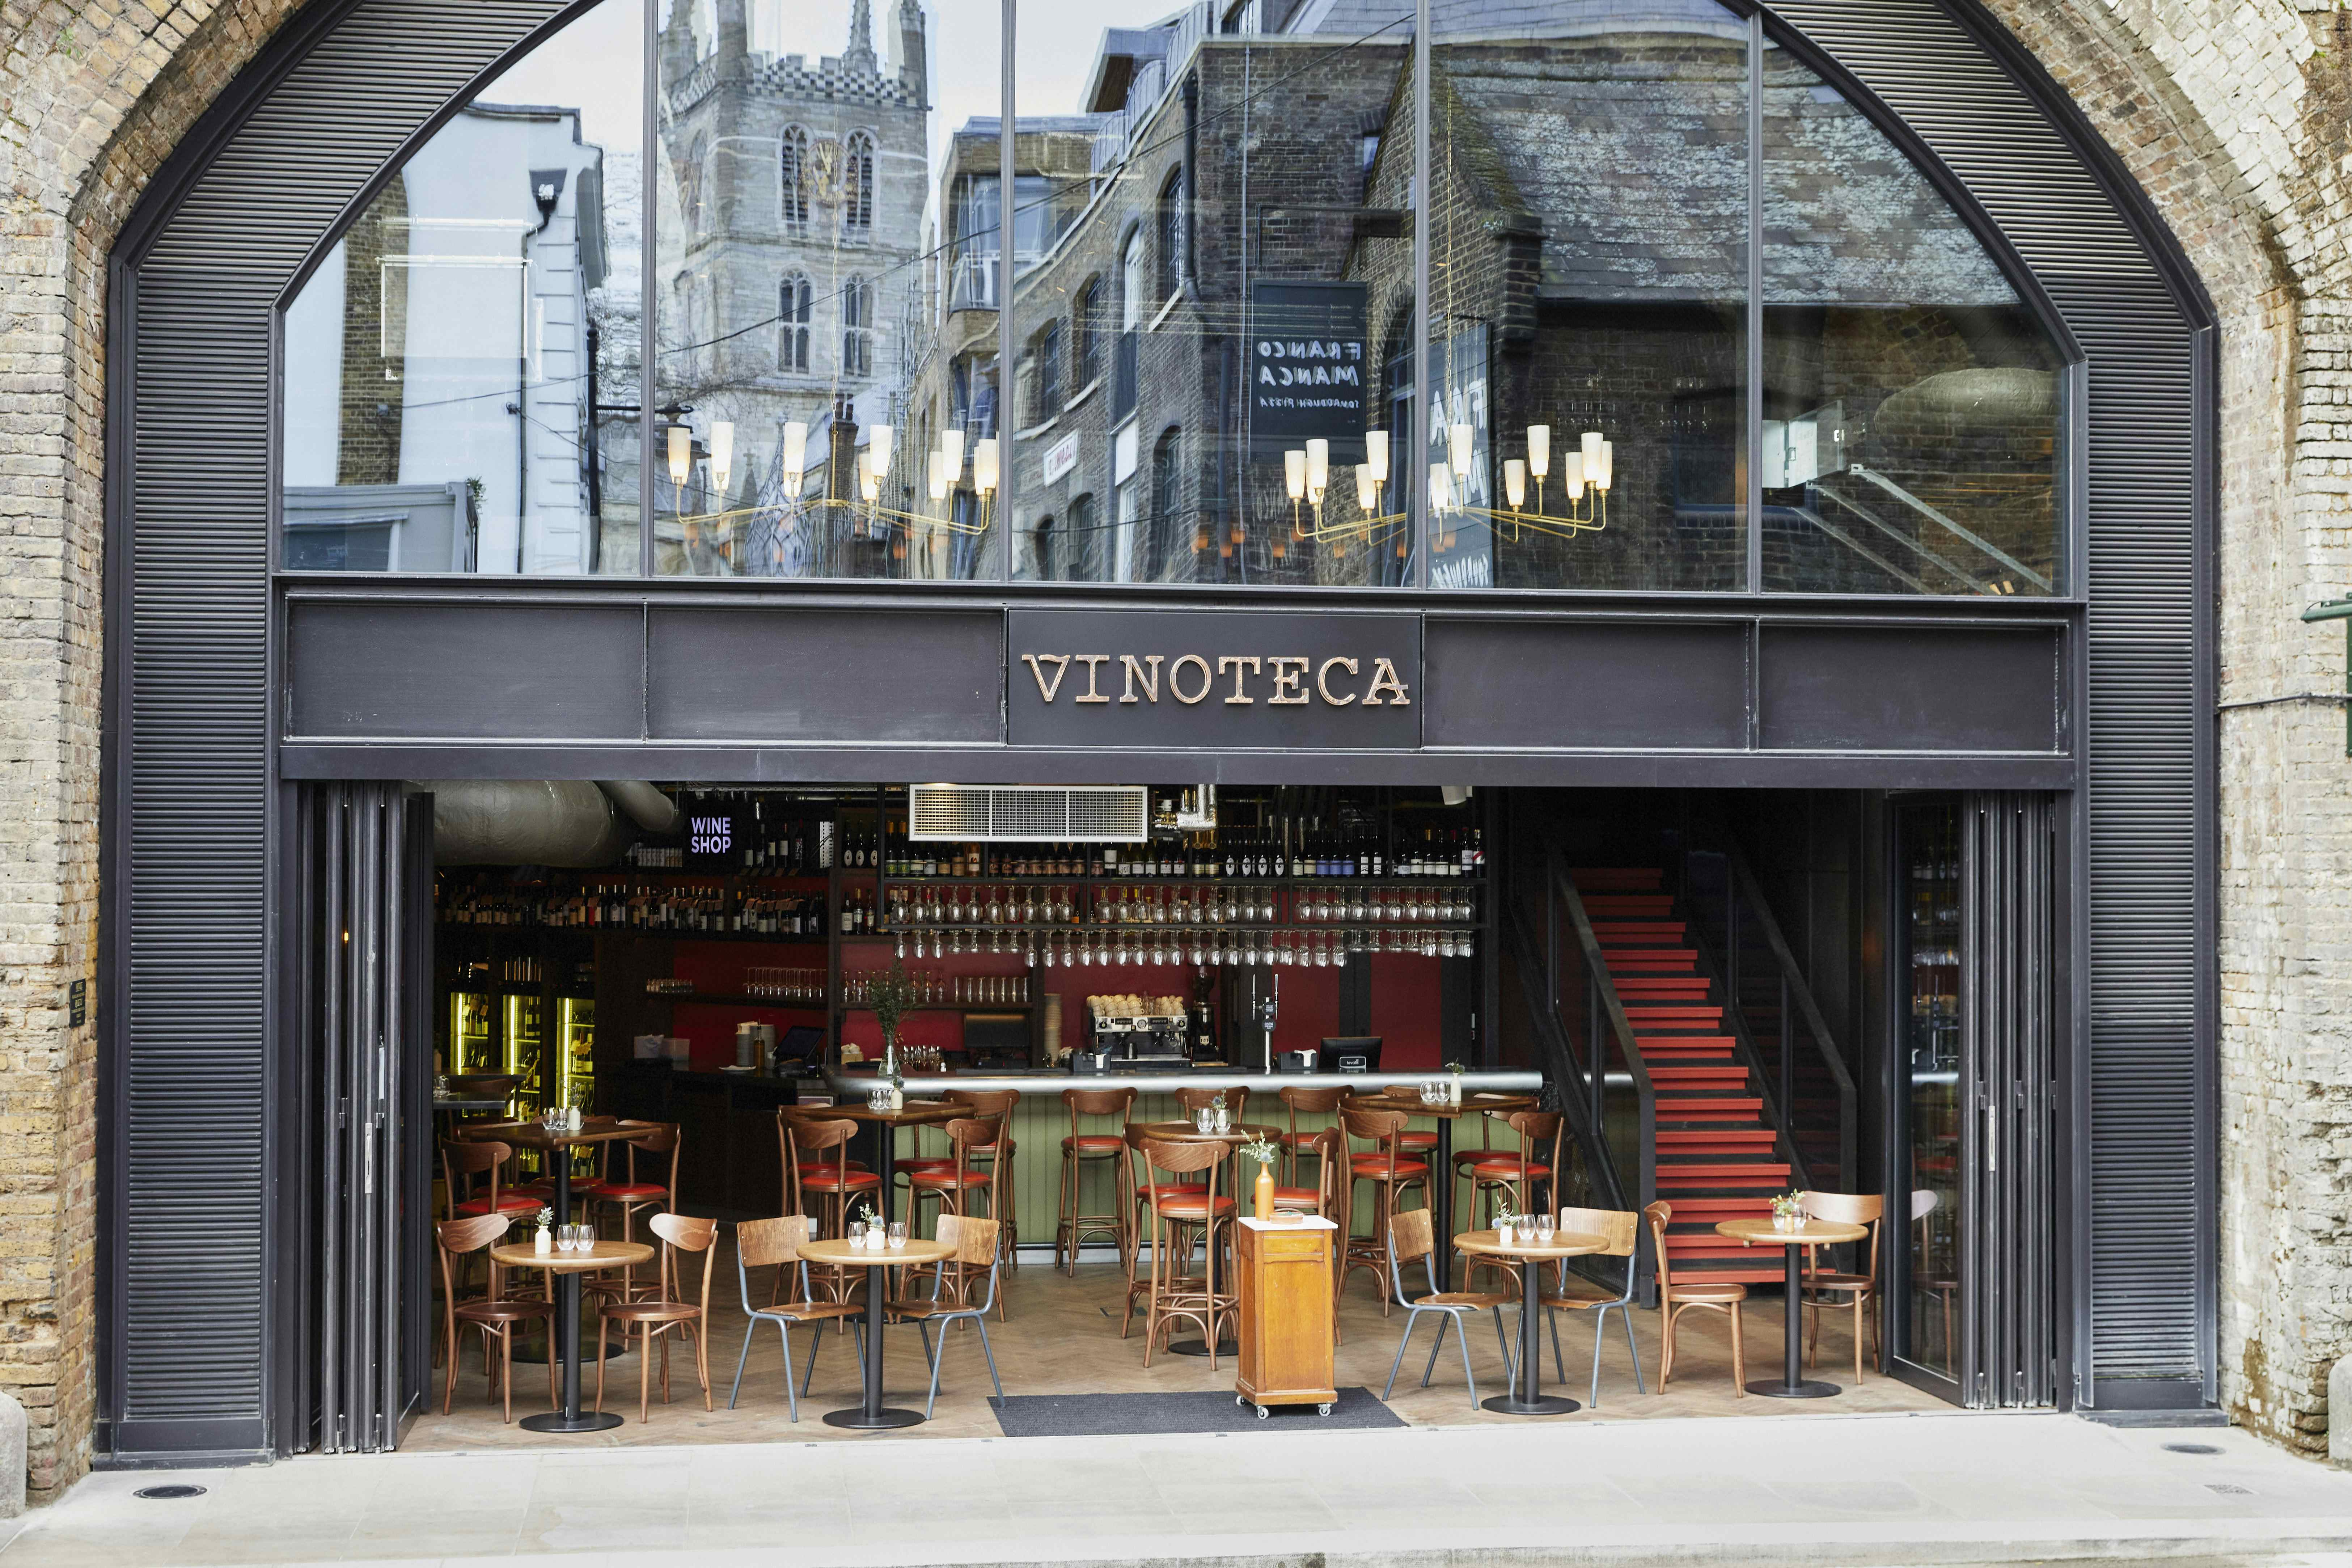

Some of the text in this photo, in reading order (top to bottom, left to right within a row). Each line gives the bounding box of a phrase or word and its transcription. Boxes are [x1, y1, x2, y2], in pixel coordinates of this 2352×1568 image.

[1022, 654, 1410, 706] VINOTECA
[691, 817, 731, 834] WINE
[691, 836, 731, 853] SHOP
